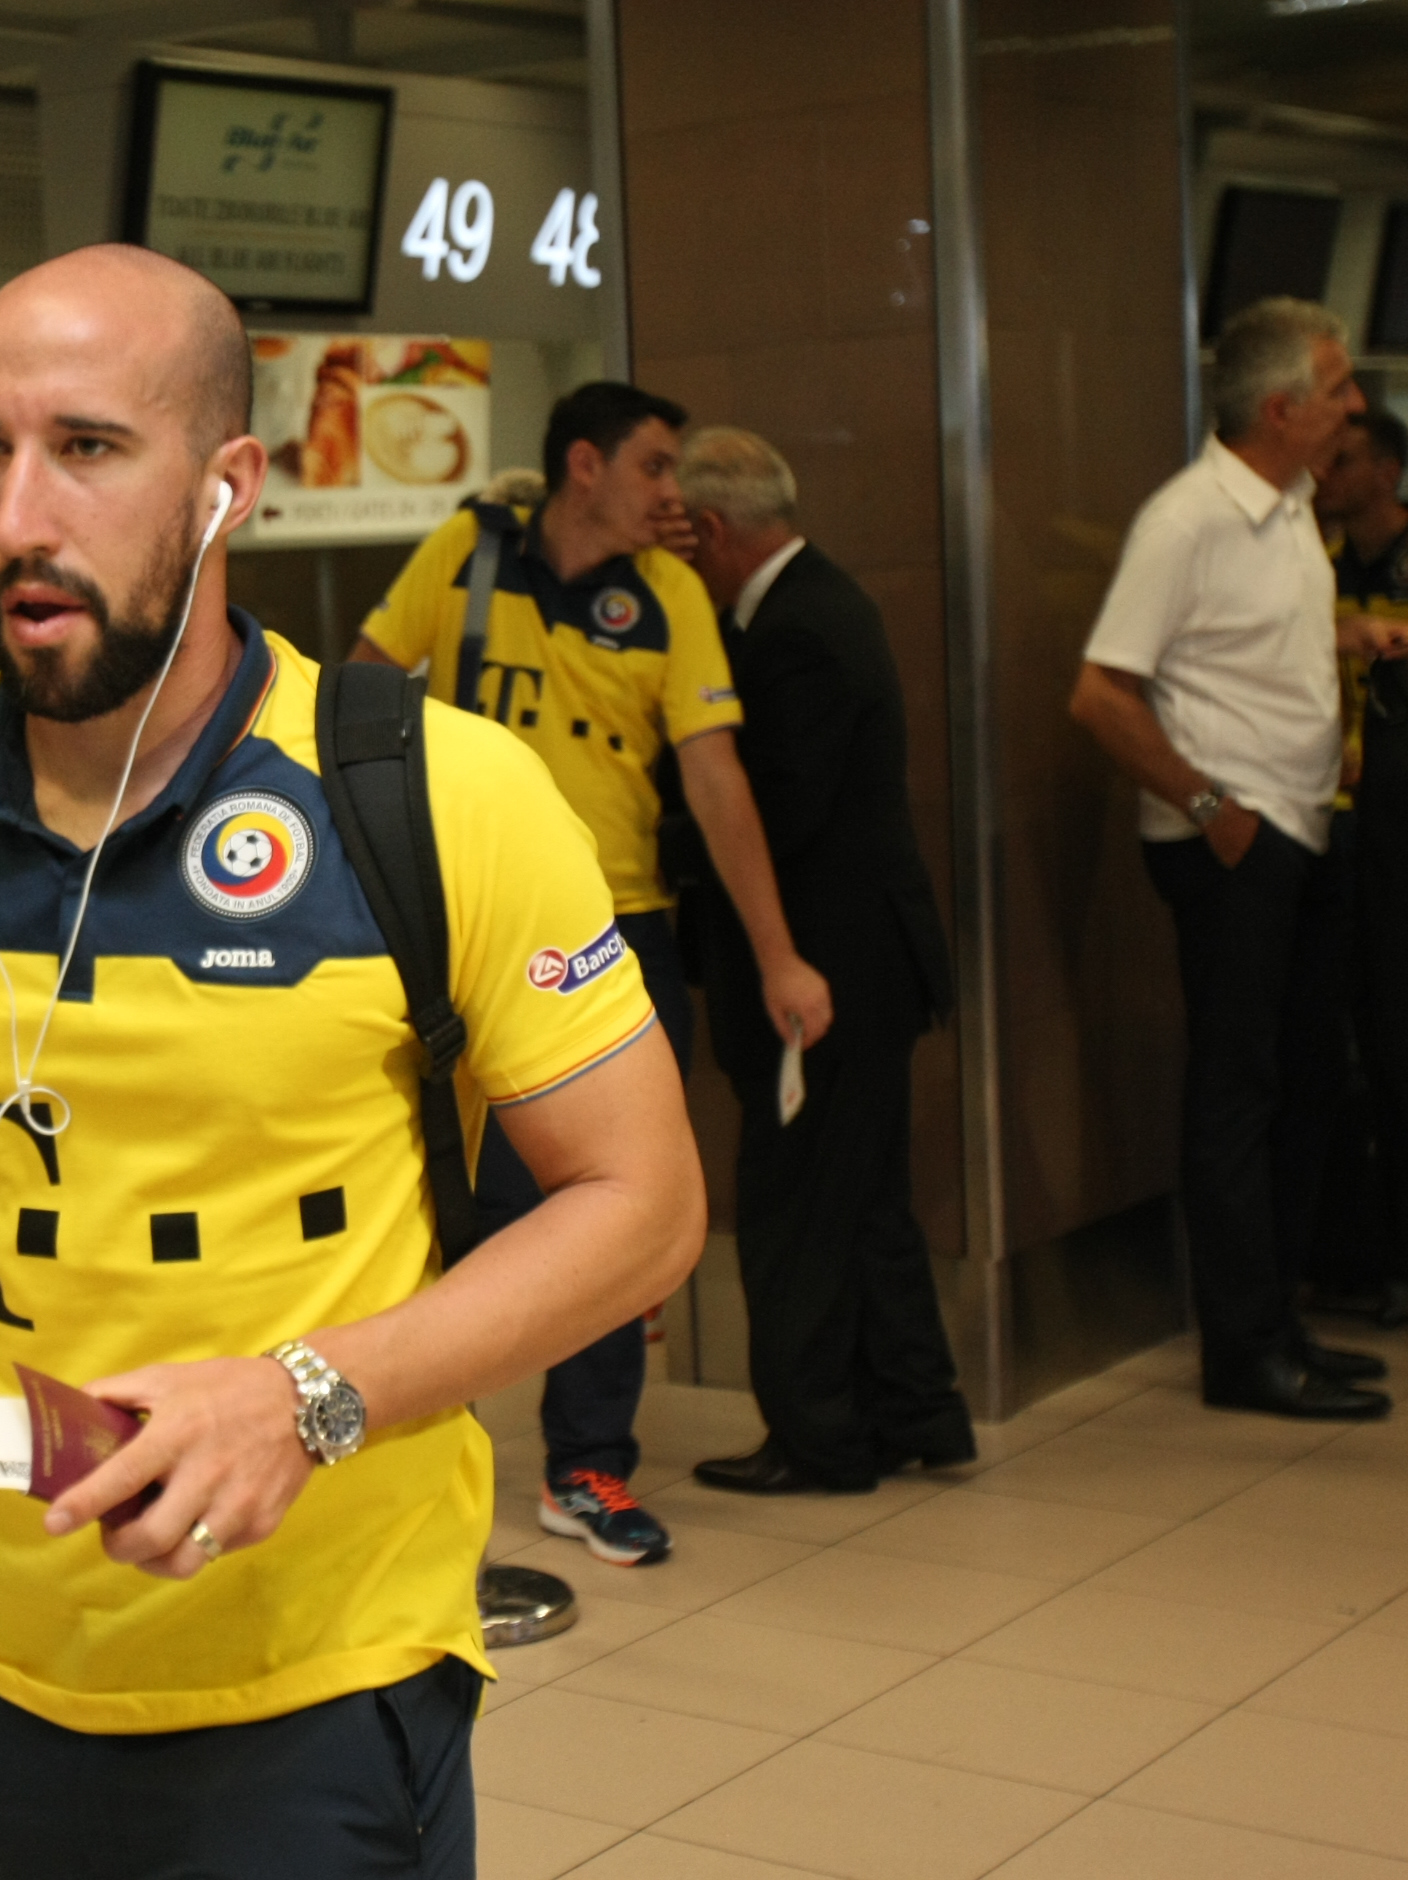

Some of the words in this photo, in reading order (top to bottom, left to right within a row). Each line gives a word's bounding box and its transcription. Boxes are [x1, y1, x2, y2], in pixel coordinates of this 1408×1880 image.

[400, 176, 495, 283] 49
[529, 187, 603, 289] 48
[192, 808, 229, 859] FEDERATIA
[229, 801, 277, 816] ROMANA
[277, 810, 290, 825] DE
[289, 821, 306, 864] FOTBAL
[193, 870, 231, 909] FONDATA
[233, 899, 245, 910] IN
[247, 893, 277, 910] ANUL
